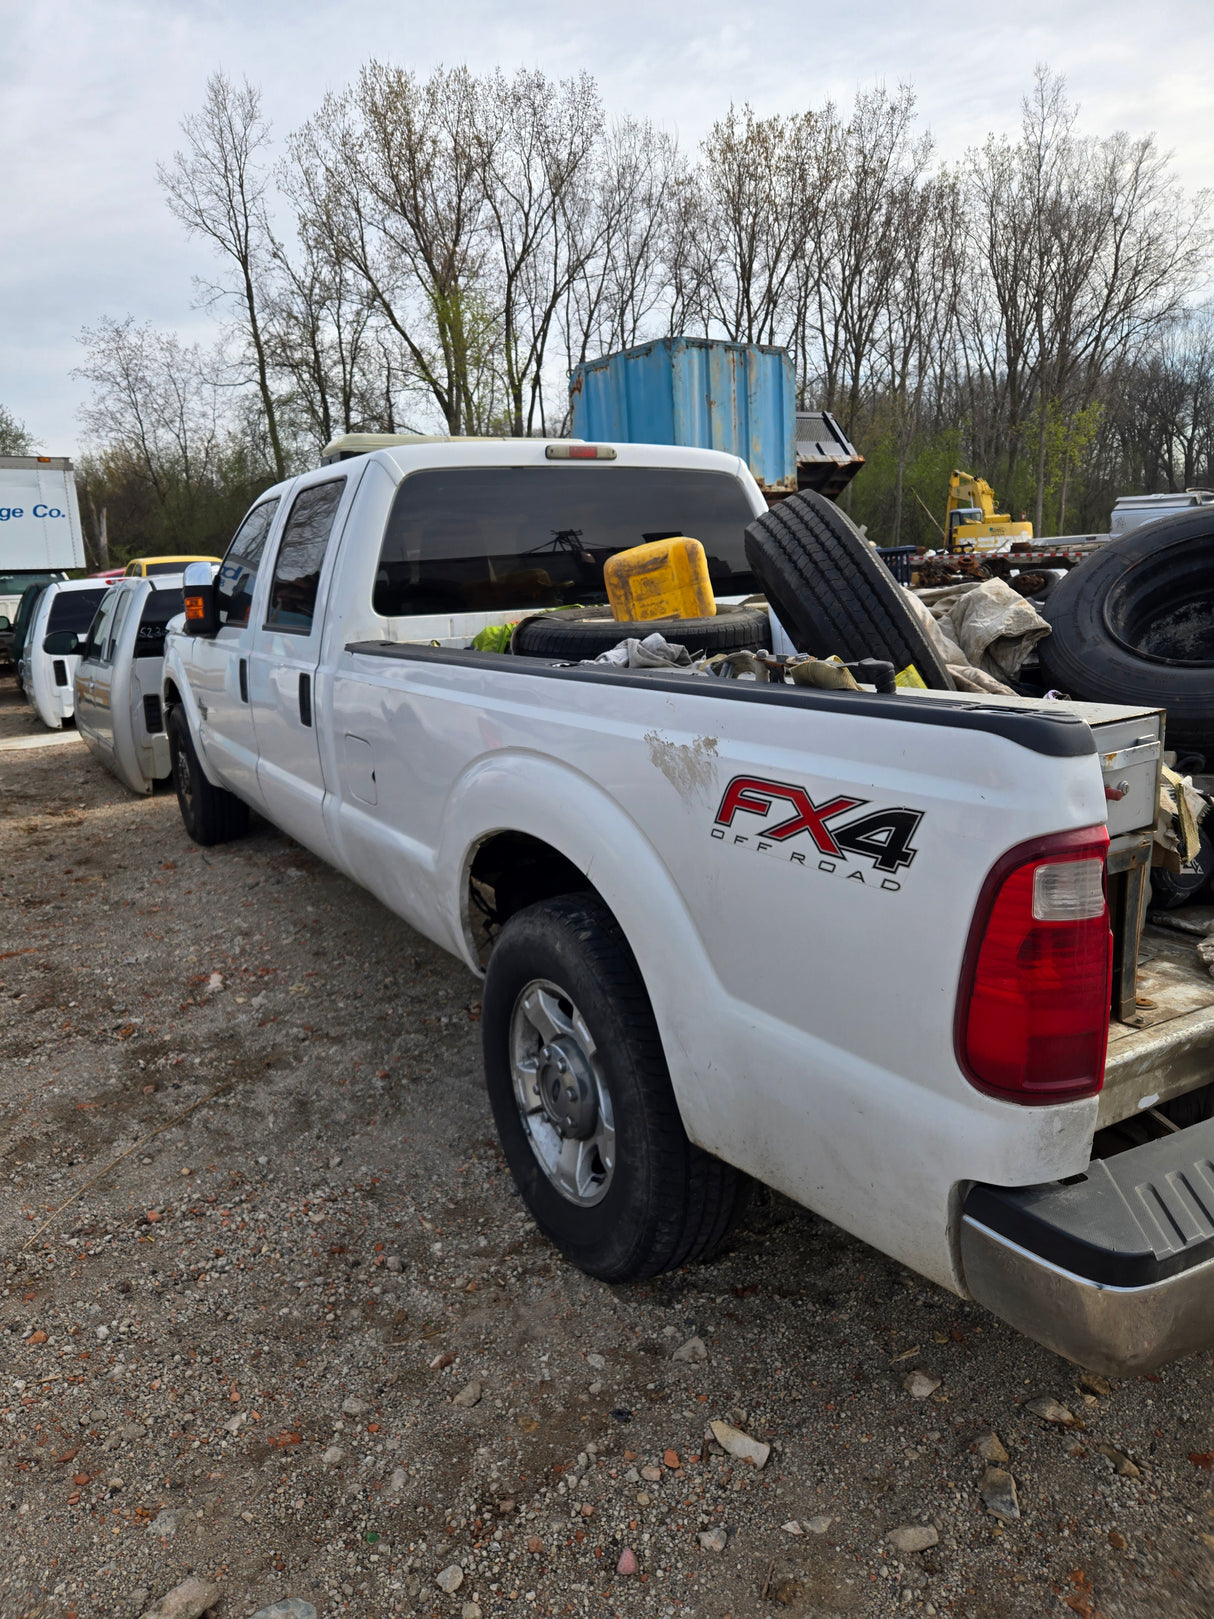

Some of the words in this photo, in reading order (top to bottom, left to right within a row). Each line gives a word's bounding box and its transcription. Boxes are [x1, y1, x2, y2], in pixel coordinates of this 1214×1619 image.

[32, 504, 66, 518] Co.
[714, 774, 926, 874] FX4
[710, 828, 773, 852] OFF
[789, 851, 901, 892] ROAD
